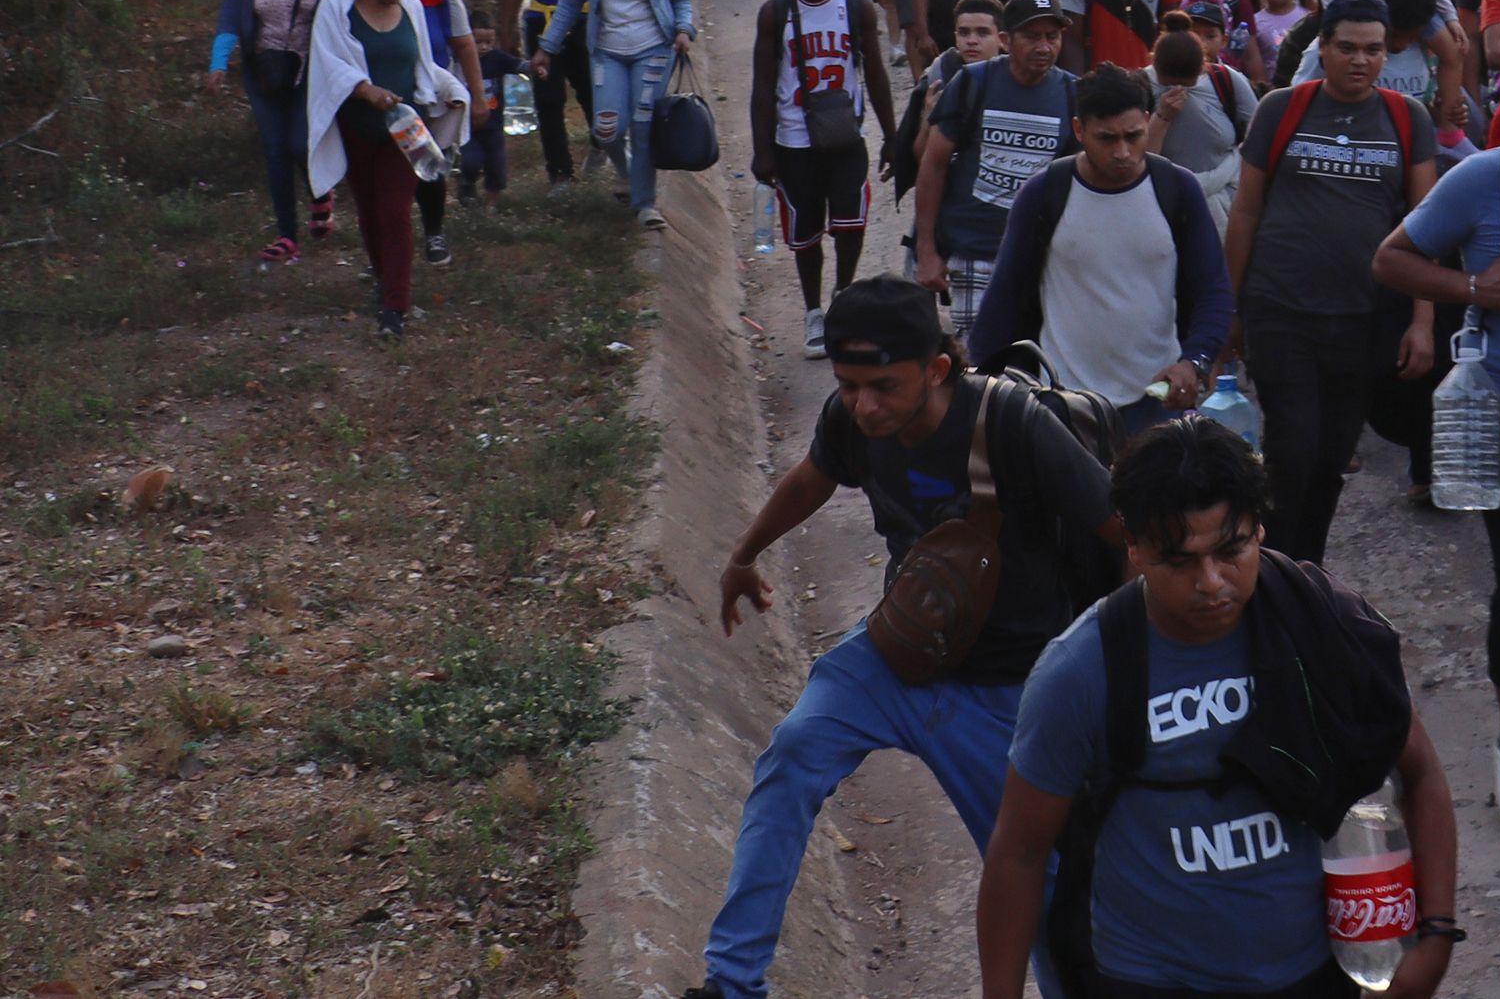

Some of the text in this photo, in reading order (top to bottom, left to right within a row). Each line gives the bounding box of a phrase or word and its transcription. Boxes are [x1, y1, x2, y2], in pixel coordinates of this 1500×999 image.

[983, 128, 1059, 150] LOVE GOD
[1300, 158, 1381, 177] BASEBALL
[1355, 147, 1398, 168] MIDDLE
[979, 167, 1011, 189] PASS
[1147, 676, 1250, 743] ECKO
